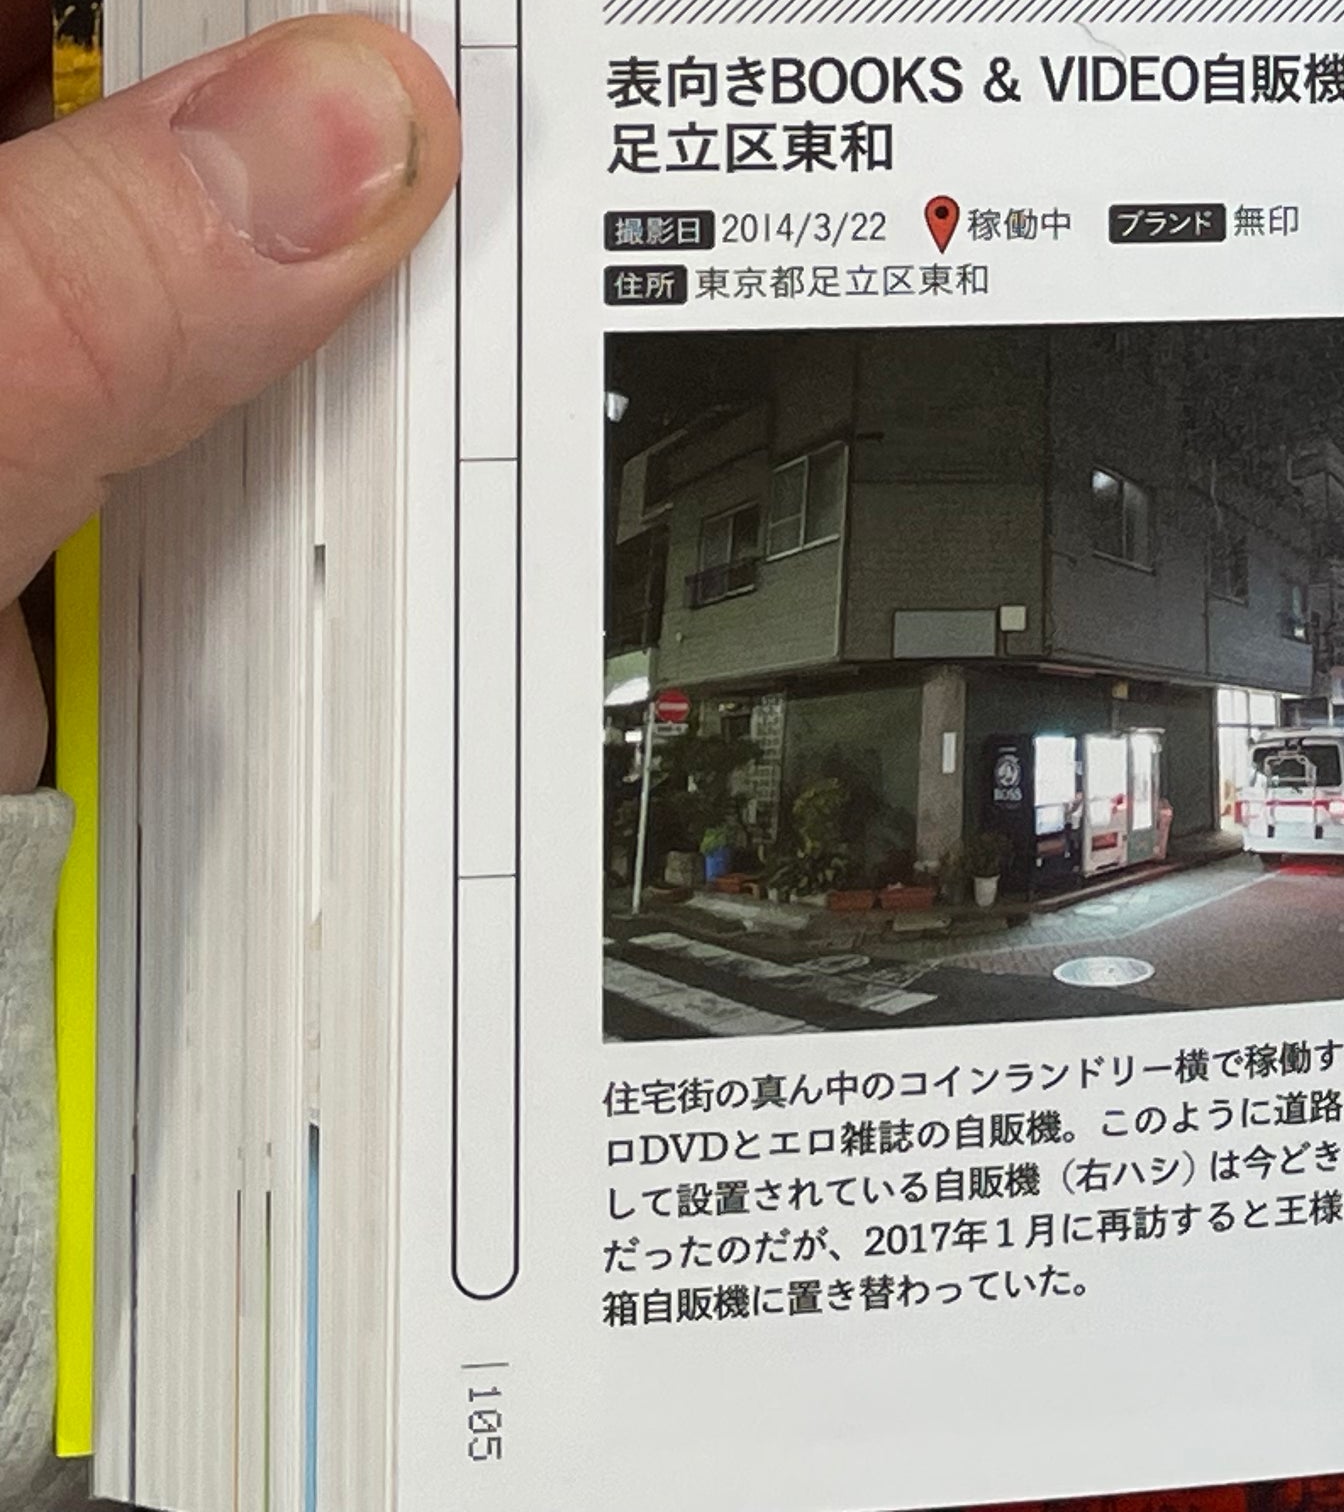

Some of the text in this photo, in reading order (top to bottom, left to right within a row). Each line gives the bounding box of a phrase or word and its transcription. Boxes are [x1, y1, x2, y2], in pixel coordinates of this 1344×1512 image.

[606, 54, 964, 109] 表向きBOOKS
[984, 57, 1022, 103] &
[606, 120, 894, 174] 足立区東和
[614, 204, 1300, 248] 撮影日 2014/3/22 稼働中 ブランド 無印
[613, 264, 989, 301] 住所 東京都足立区東和
[602, 1261, 1090, 1329] 箱自販機に置き替わっていた。
[467, 1386, 502, 1462] 105
